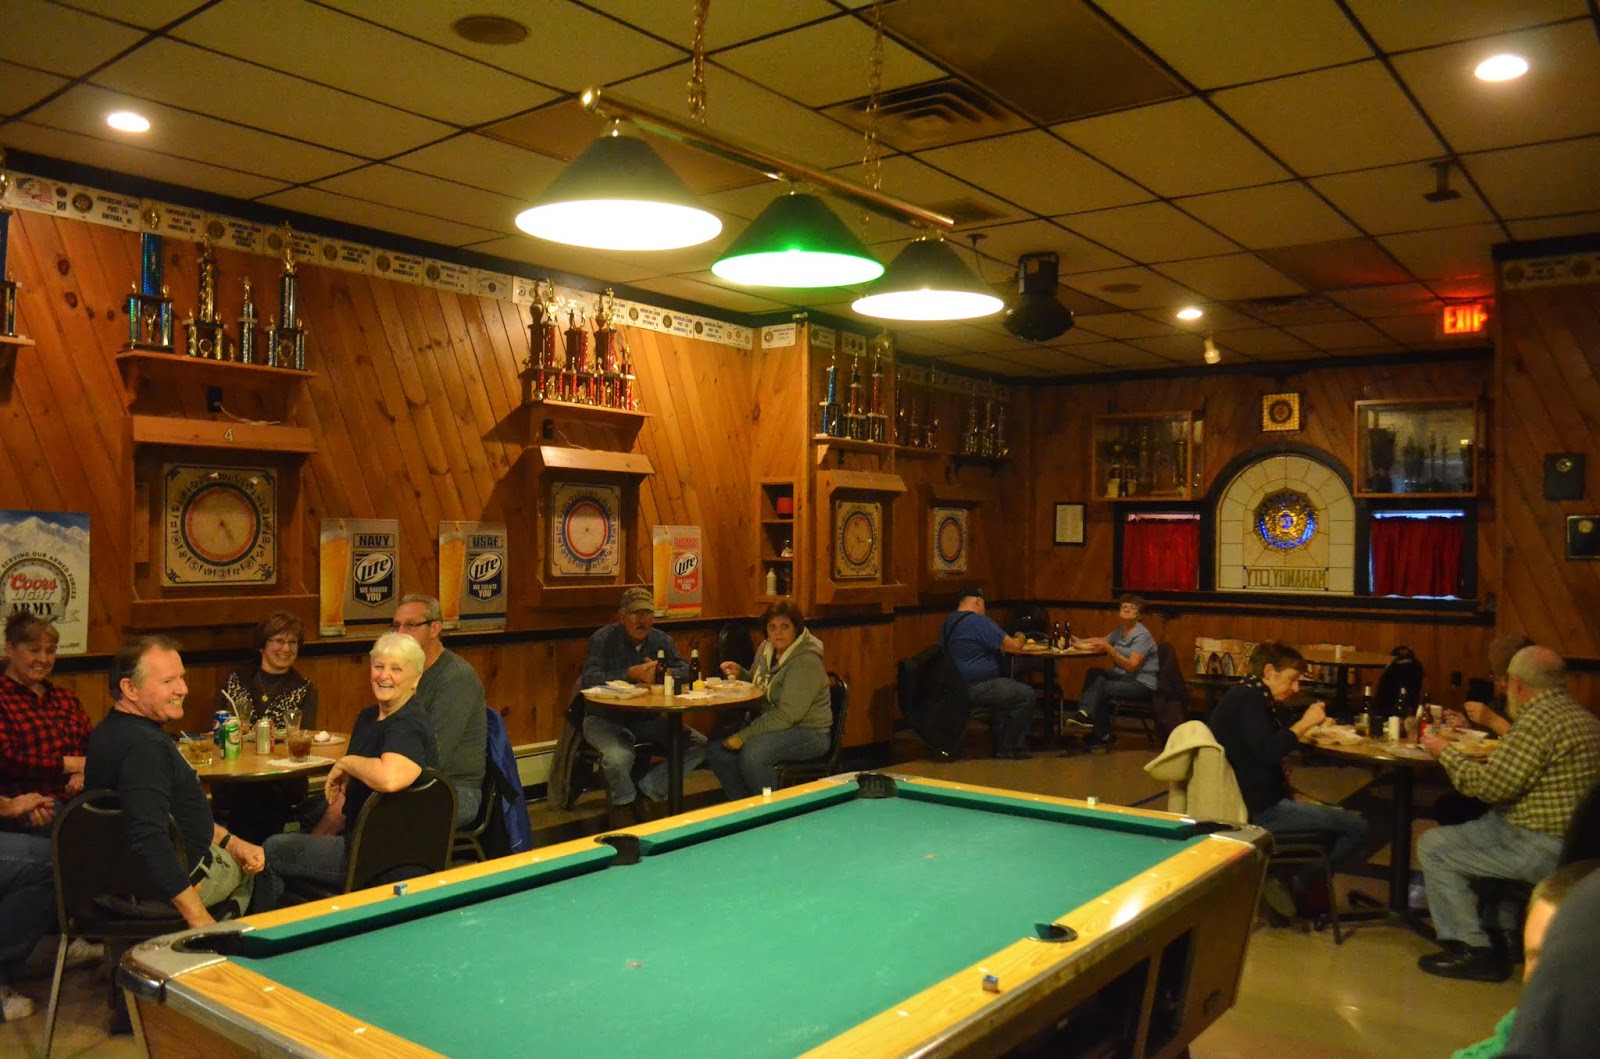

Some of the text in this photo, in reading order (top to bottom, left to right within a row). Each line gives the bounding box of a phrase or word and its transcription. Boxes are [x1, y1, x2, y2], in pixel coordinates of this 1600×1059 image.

[1444, 305, 1483, 334] EXIT
[224, 428, 233, 441] 4
[360, 535, 389, 546] NAVY
[473, 536, 498, 547] USAF
[361, 559, 388, 582] Lite
[474, 559, 498, 580] Lite
[679, 557, 696, 575] Lite
[1, 551, 30, 569] SERVING
[49, 556, 69, 573] ARMED
[68, 573, 77, 600] FORCES
[10, 572, 58, 591] Coors
[12, 590, 55, 601] LIGHT
[366, 592, 381, 601] YOU
[479, 589, 492, 598] YOU
[10, 602, 55, 615] ARMY
